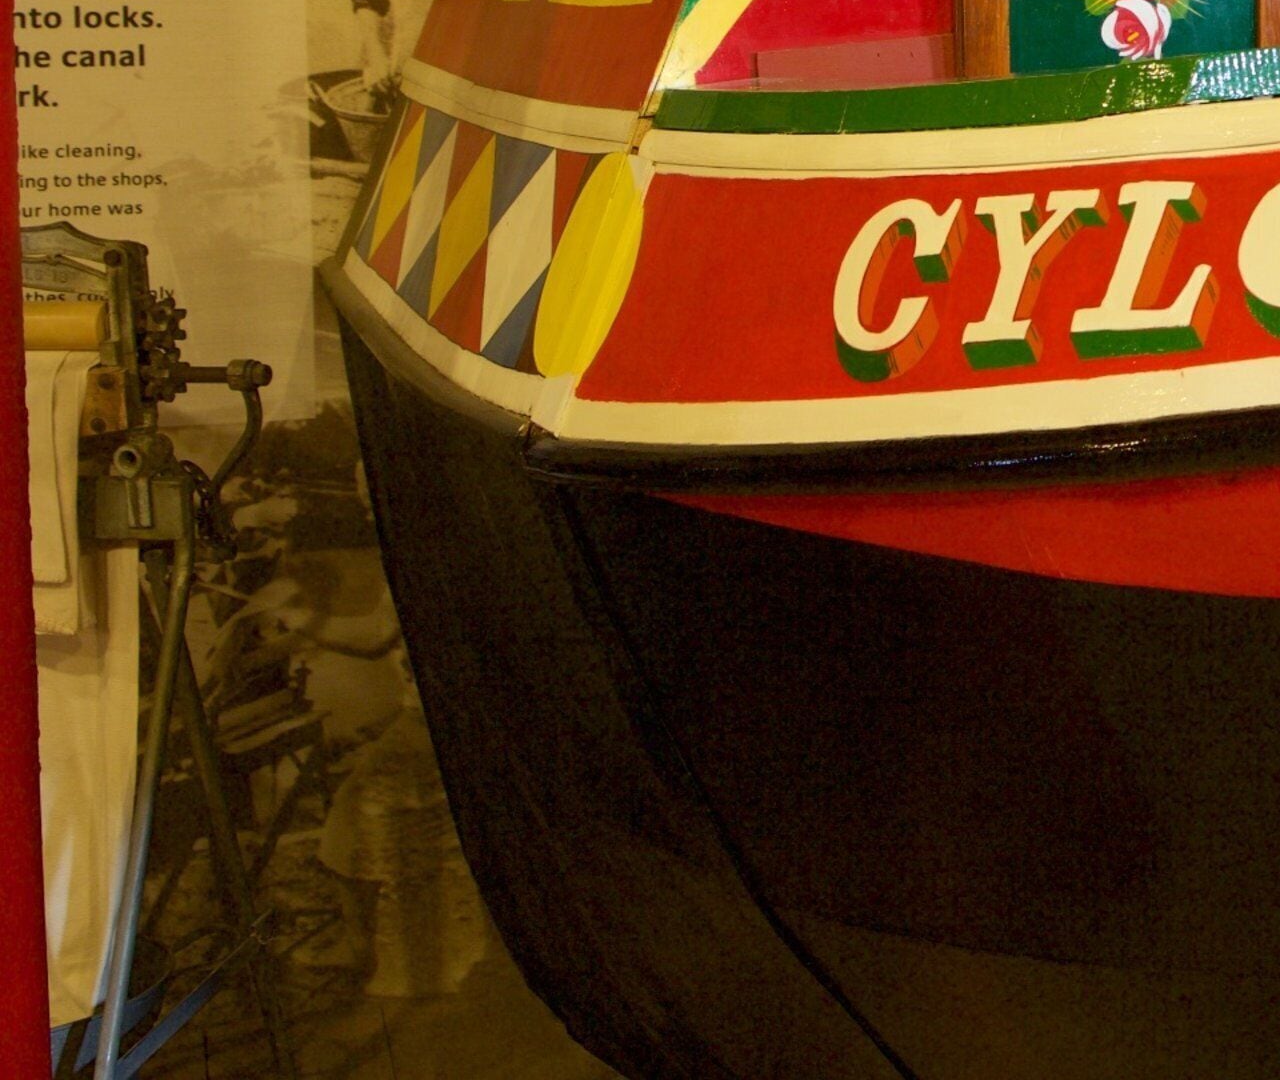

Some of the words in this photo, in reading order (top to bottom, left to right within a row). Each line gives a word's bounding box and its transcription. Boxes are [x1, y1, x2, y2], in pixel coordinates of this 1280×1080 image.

[74, 6, 163, 29] locks.
[62, 44, 146, 68] canal
[55, 143, 142, 160] cleaning,
[54, 175, 72, 187] to
[77, 173, 107, 187] the
[112, 172, 168, 188] shops,
[48, 203, 102, 217] home
[107, 203, 143, 216] was
